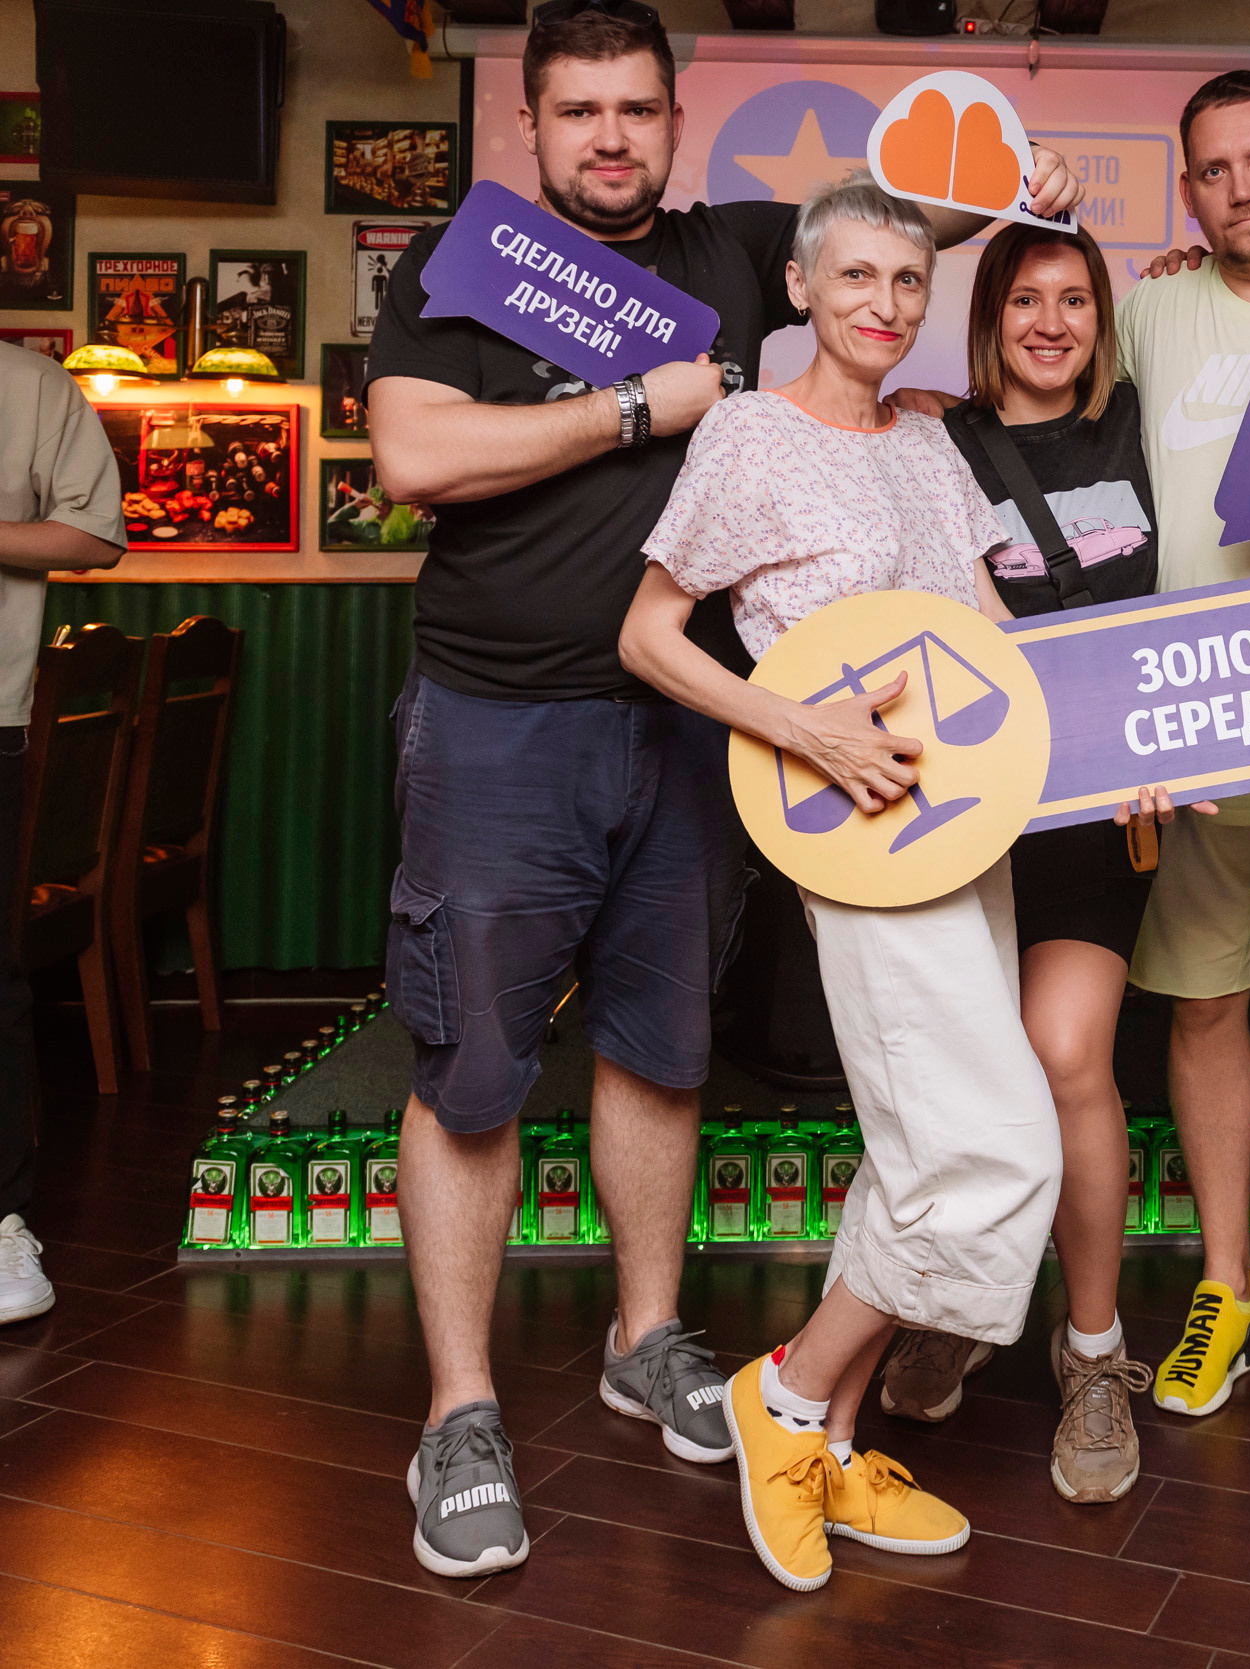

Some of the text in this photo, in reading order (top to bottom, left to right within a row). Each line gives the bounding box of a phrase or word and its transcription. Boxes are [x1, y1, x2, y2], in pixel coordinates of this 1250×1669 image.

[1076, 155, 1120, 185] ЭТО
[1078, 197, 1125, 226] МИ!
[97, 260, 177, 273] ТРЕХГОРНОЕ
[490, 223, 677, 344] СДЕЛАНО ДЛЯ
[357, 316, 375, 327] NERV
[504, 280, 622, 358] ДРУЗЕЙ!
[1164, 1292, 1223, 1388] HUMAN
[686, 1385, 724, 1411] PUM
[440, 1482, 510, 1519] PUMA
